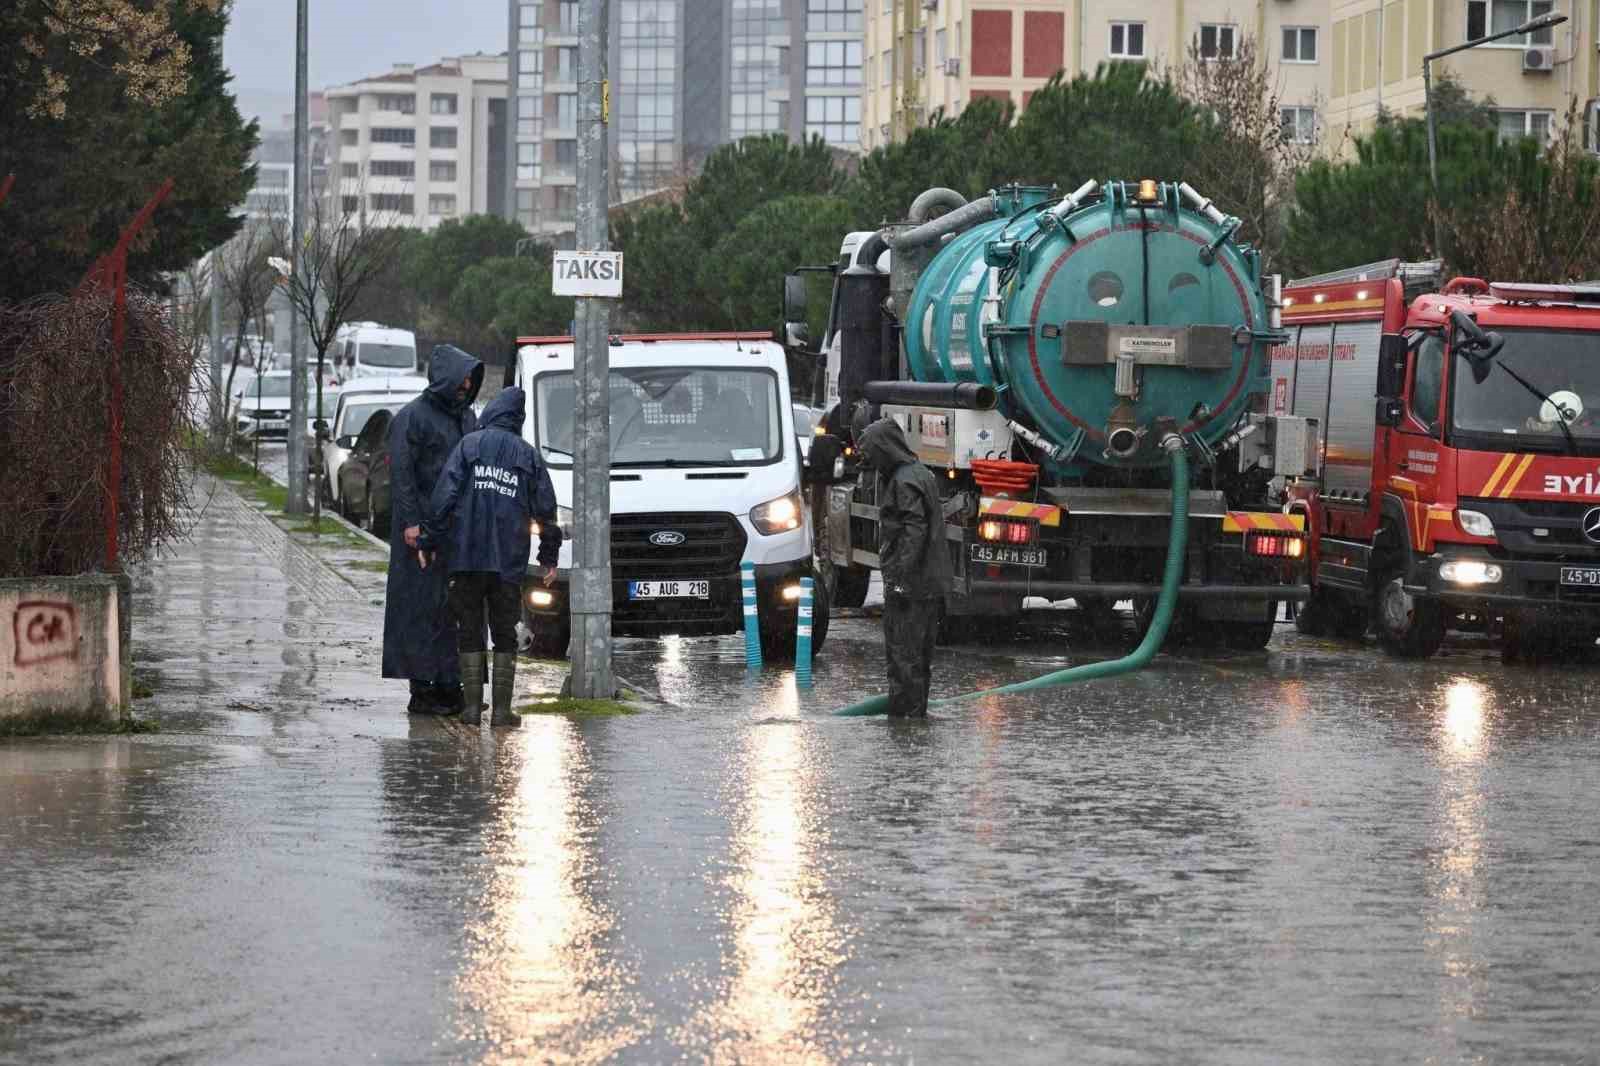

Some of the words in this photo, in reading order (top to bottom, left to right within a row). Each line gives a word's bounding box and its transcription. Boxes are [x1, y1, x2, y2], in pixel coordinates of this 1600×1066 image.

[978, 547, 993, 560] 45
[1567, 570, 1583, 582] 45
[637, 582, 650, 595] 45
[659, 582, 679, 595] AUG
[688, 582, 708, 595] 218
